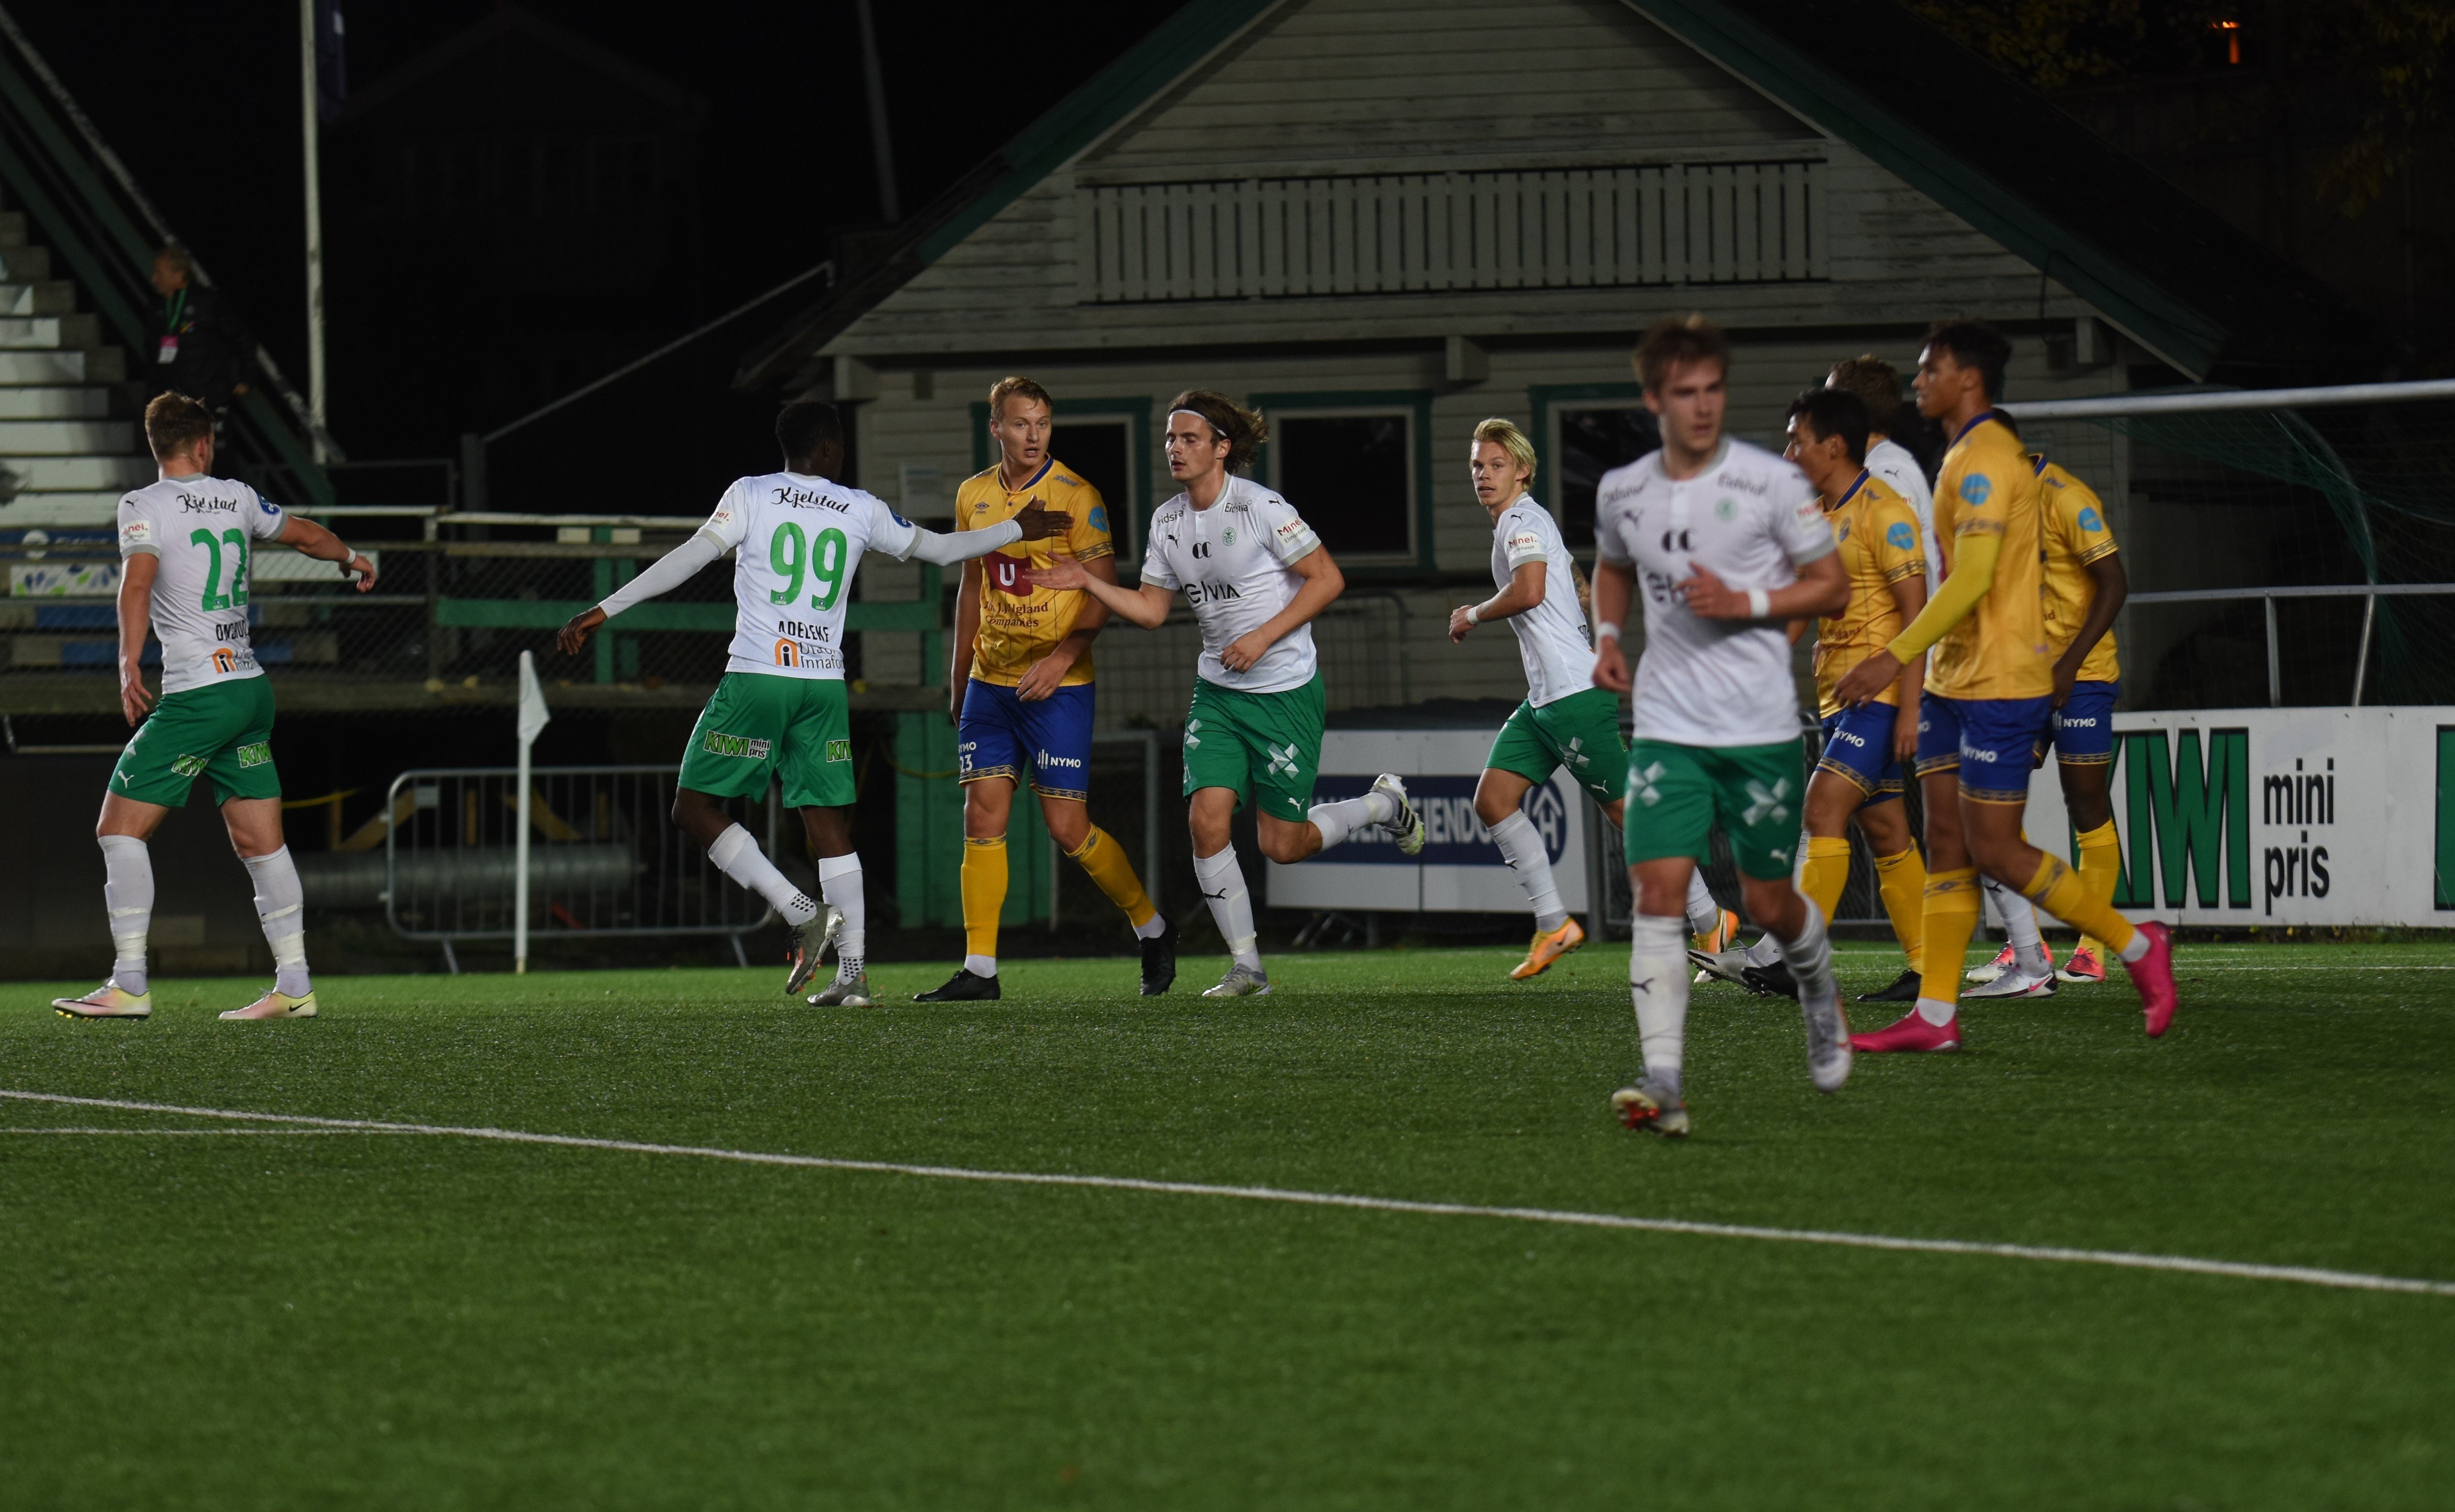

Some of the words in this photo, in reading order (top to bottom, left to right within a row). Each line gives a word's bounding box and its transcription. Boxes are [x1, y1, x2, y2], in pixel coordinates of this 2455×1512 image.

[771, 486, 850, 514] Kjelstad
[1277, 517, 1303, 536] Minel.
[190, 527, 249, 612] 22
[770, 522, 848, 612] 99
[999, 563, 1015, 586] U
[778, 620, 829, 642] ADELEKE
[2063, 717, 2097, 728] NYMO
[705, 731, 750, 756] KIWI
[750, 739, 770, 750] mini
[1834, 729, 1865, 748] NYMO
[239, 741, 272, 767] KIW
[749, 748, 766, 758] pris
[960, 754, 973, 773] 23
[1051, 756, 1081, 768] NYMO
[1962, 745, 1998, 763] NYMO
[2263, 758, 2334, 825] mini
[2264, 830, 2330, 916] pris
